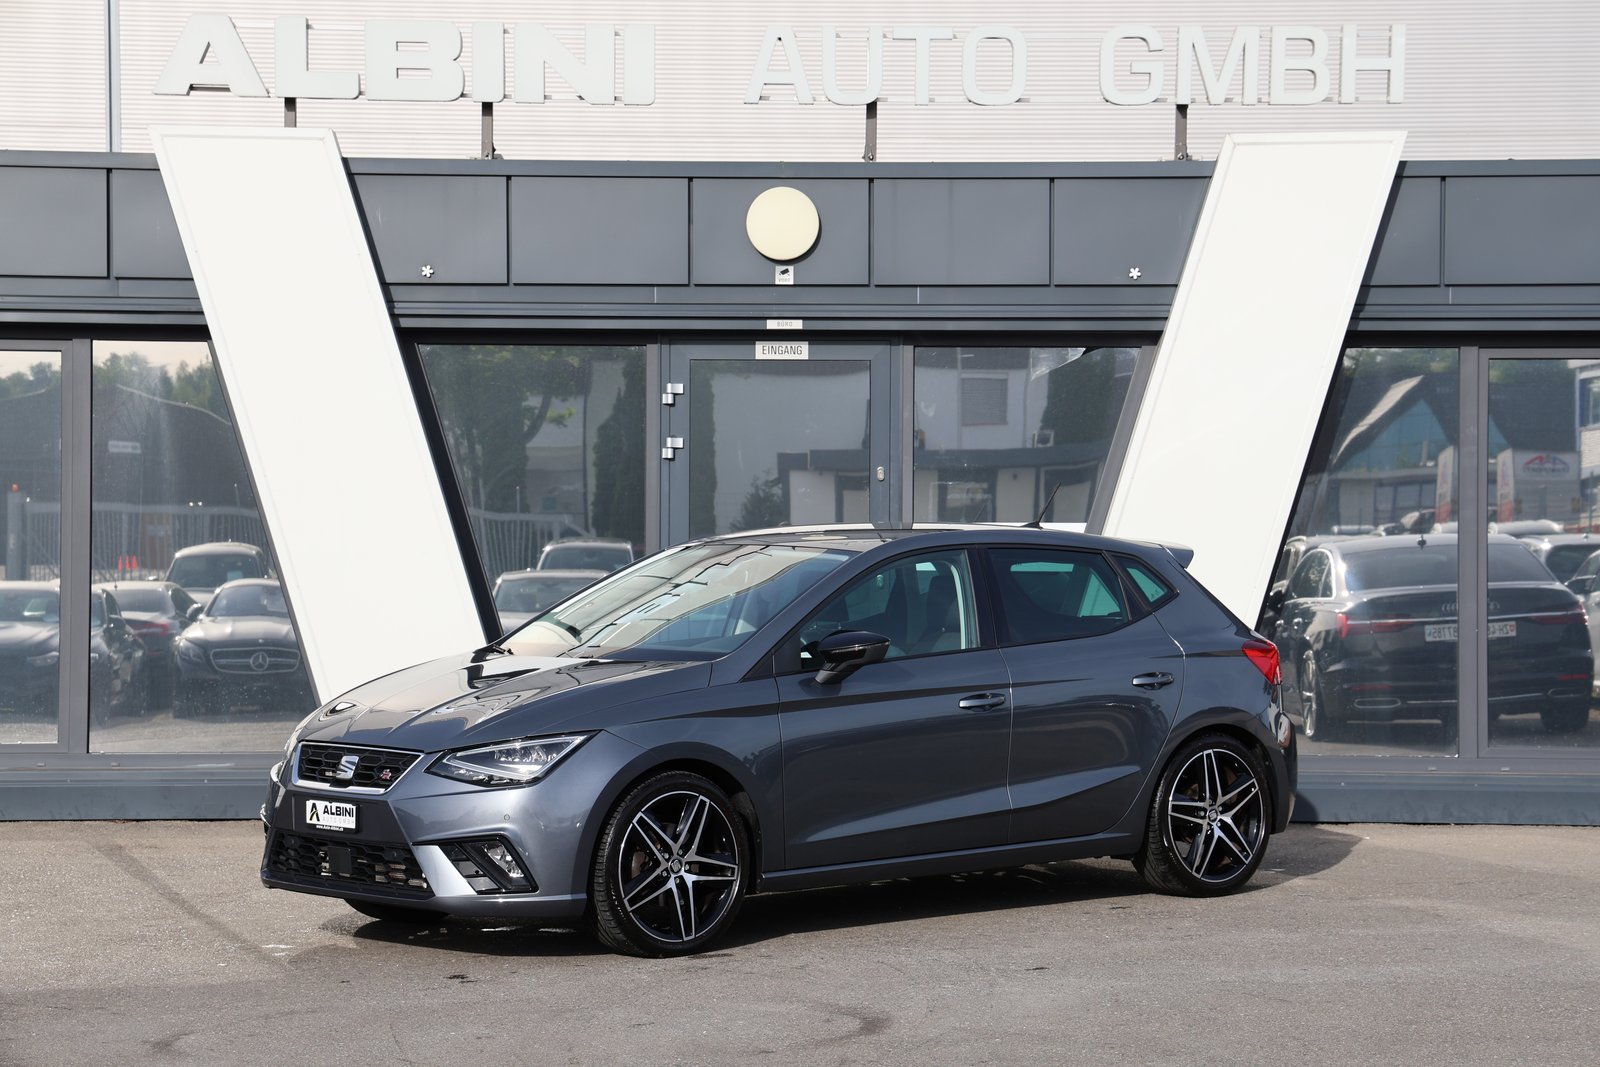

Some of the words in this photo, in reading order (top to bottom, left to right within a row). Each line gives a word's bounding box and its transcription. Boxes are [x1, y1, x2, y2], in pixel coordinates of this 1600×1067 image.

[152, 13, 656, 106] ALBINI
[743, 24, 1027, 106] AUTO
[1099, 24, 1407, 106] GMBH
[762, 345, 803, 355] EINGANG
[323, 804, 354, 818] ALBINI
